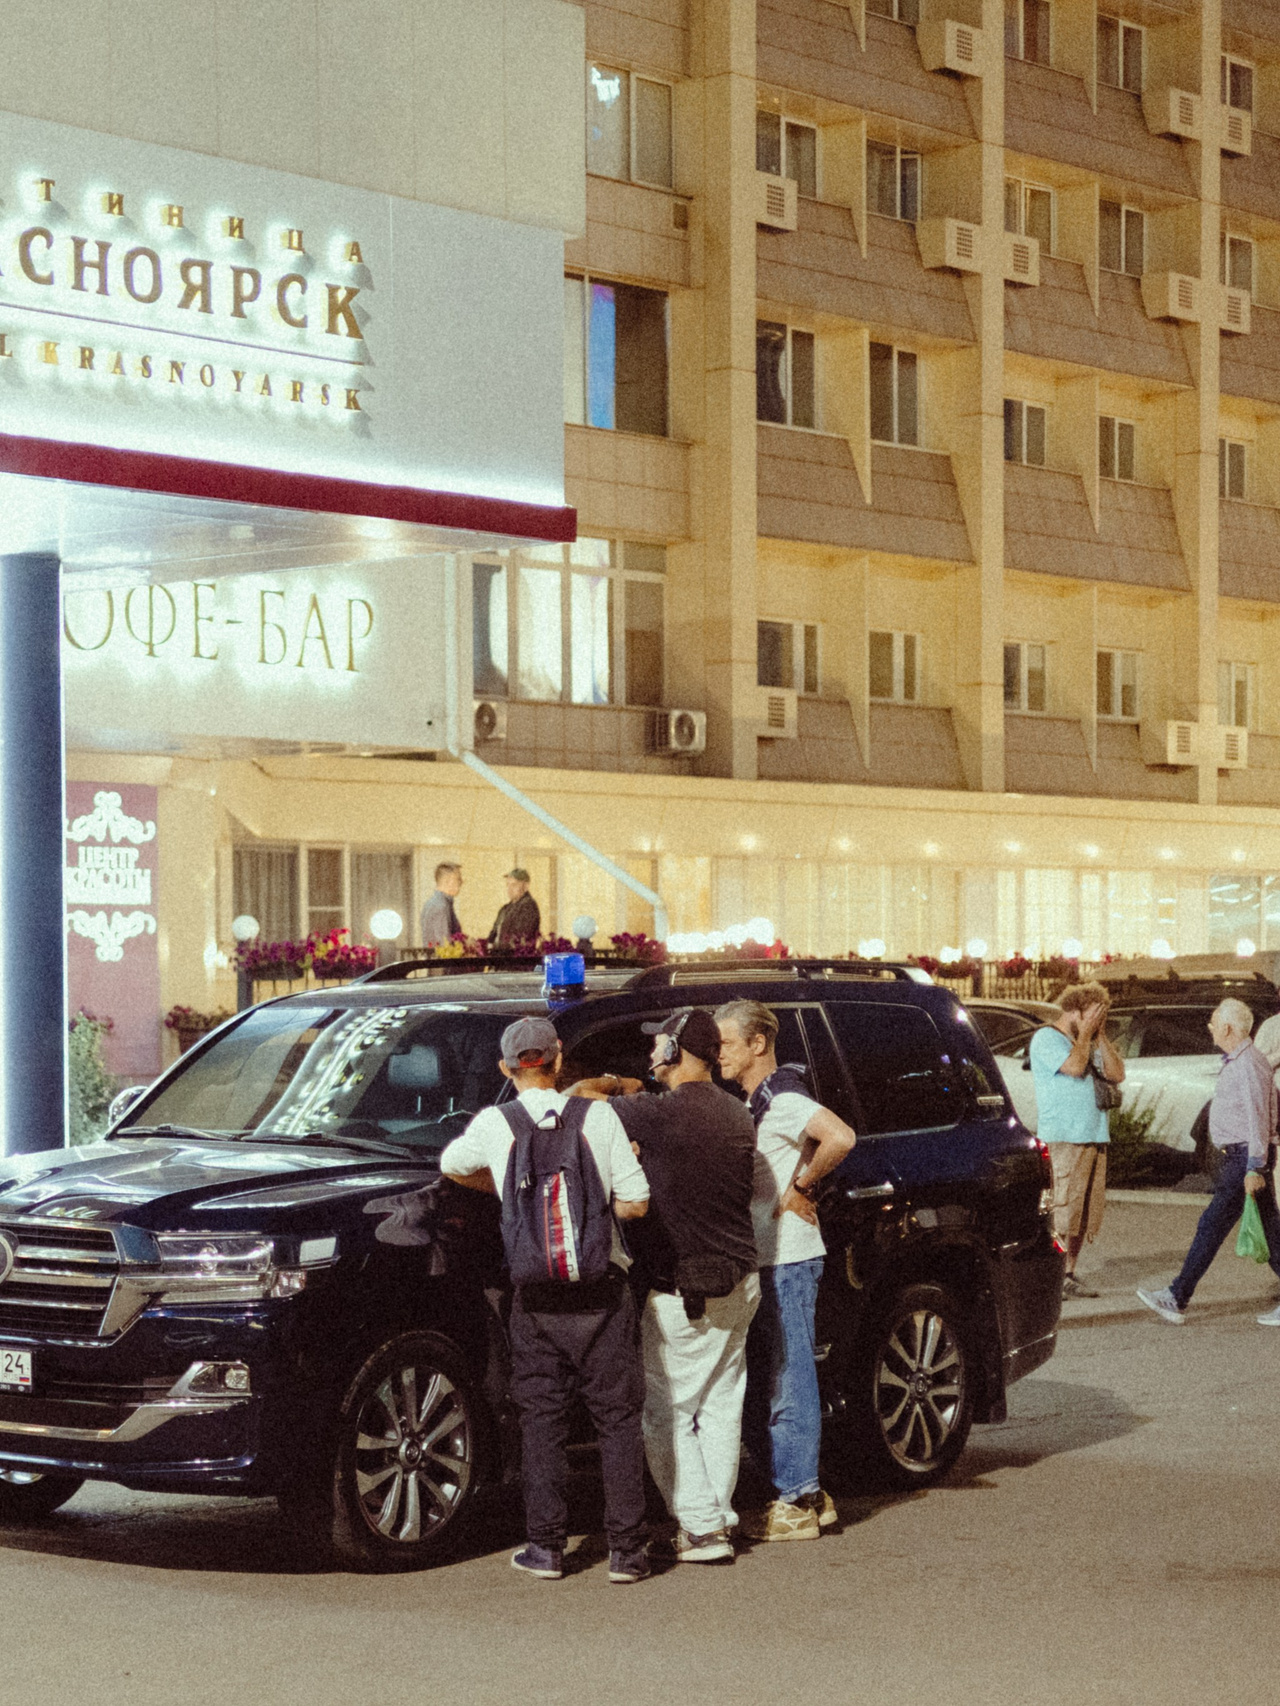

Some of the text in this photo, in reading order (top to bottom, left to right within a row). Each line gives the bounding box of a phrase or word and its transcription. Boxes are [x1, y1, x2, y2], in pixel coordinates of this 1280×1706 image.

[43, 341, 363, 411] KRASNOYARSK
[63, 581, 374, 672] ОФЕ-БАР
[78, 846, 139, 868] ЦЕНТР
